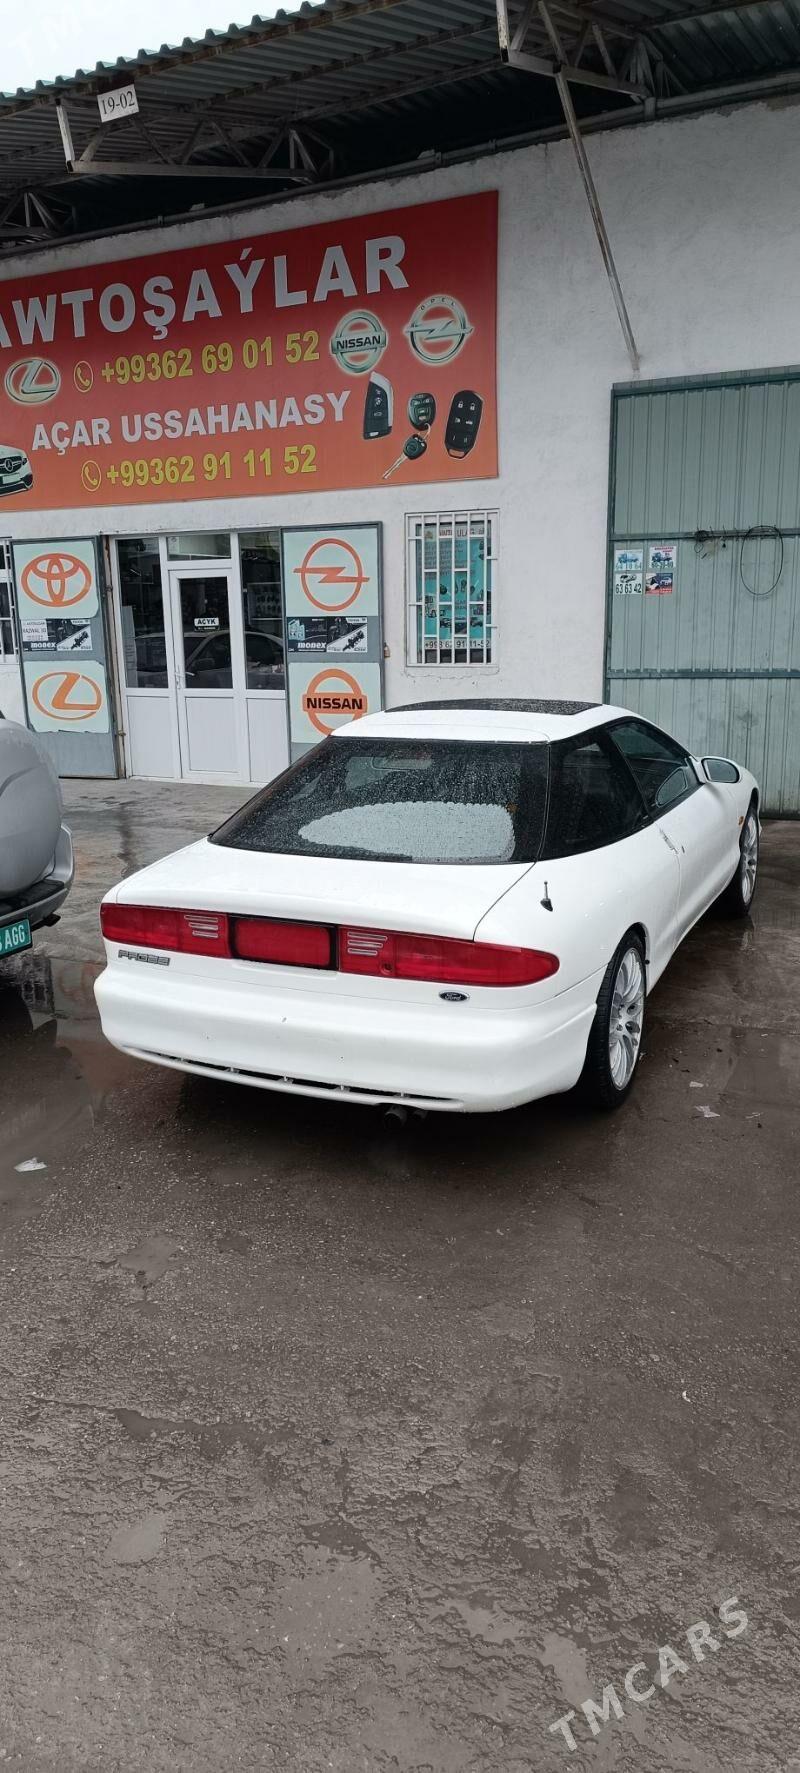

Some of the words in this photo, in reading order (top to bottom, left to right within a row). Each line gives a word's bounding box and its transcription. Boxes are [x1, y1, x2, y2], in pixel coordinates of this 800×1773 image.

[102, 90, 136, 115] 19-02
[421, 297, 455, 311] OPEL
[336, 334, 382, 350] NISSAN
[101, 348, 193, 384] +99362
[202, 343, 234, 373] 69
[242, 337, 273, 369] 01
[285, 330, 320, 362] 52
[31, 416, 112, 455] AÇAR
[121, 390, 351, 443] USSAHANASY
[106, 455, 195, 487] +99362
[204, 450, 232, 481] 91
[243, 447, 272, 477] 11
[284, 444, 317, 474] 52
[615, 583, 624, 593] 63
[624, 583, 633, 593] 63
[633, 583, 642, 593] 42
[306, 697, 363, 710] NISSAN
[118, 949, 171, 966] PROBE
